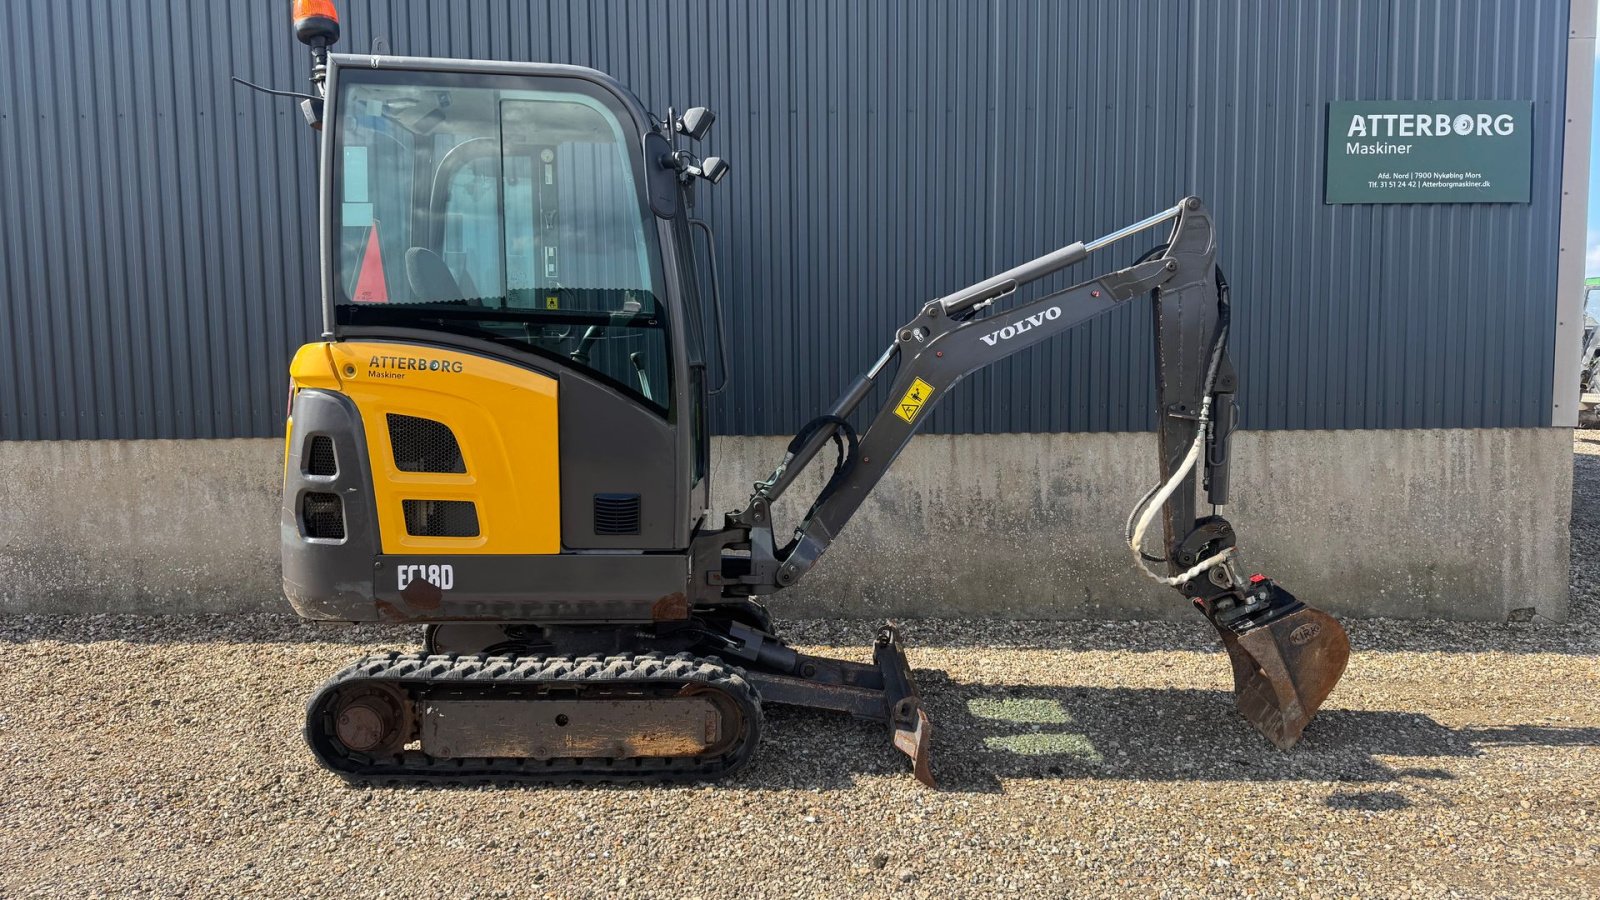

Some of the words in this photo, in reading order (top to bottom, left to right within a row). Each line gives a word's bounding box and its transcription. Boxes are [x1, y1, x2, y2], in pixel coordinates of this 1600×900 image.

[1347, 113, 1514, 137] ATTERBORG
[1346, 142, 1412, 155] Maskiner
[1433, 172, 1464, 180] Nykøbing
[1422, 181, 1491, 189] Atterborgmaskiner.dk
[979, 306, 1062, 346] VOLVO
[369, 355, 463, 373] ATTERBORG
[368, 370, 405, 379] Maskiner
[1291, 624, 1319, 643] KIRK
